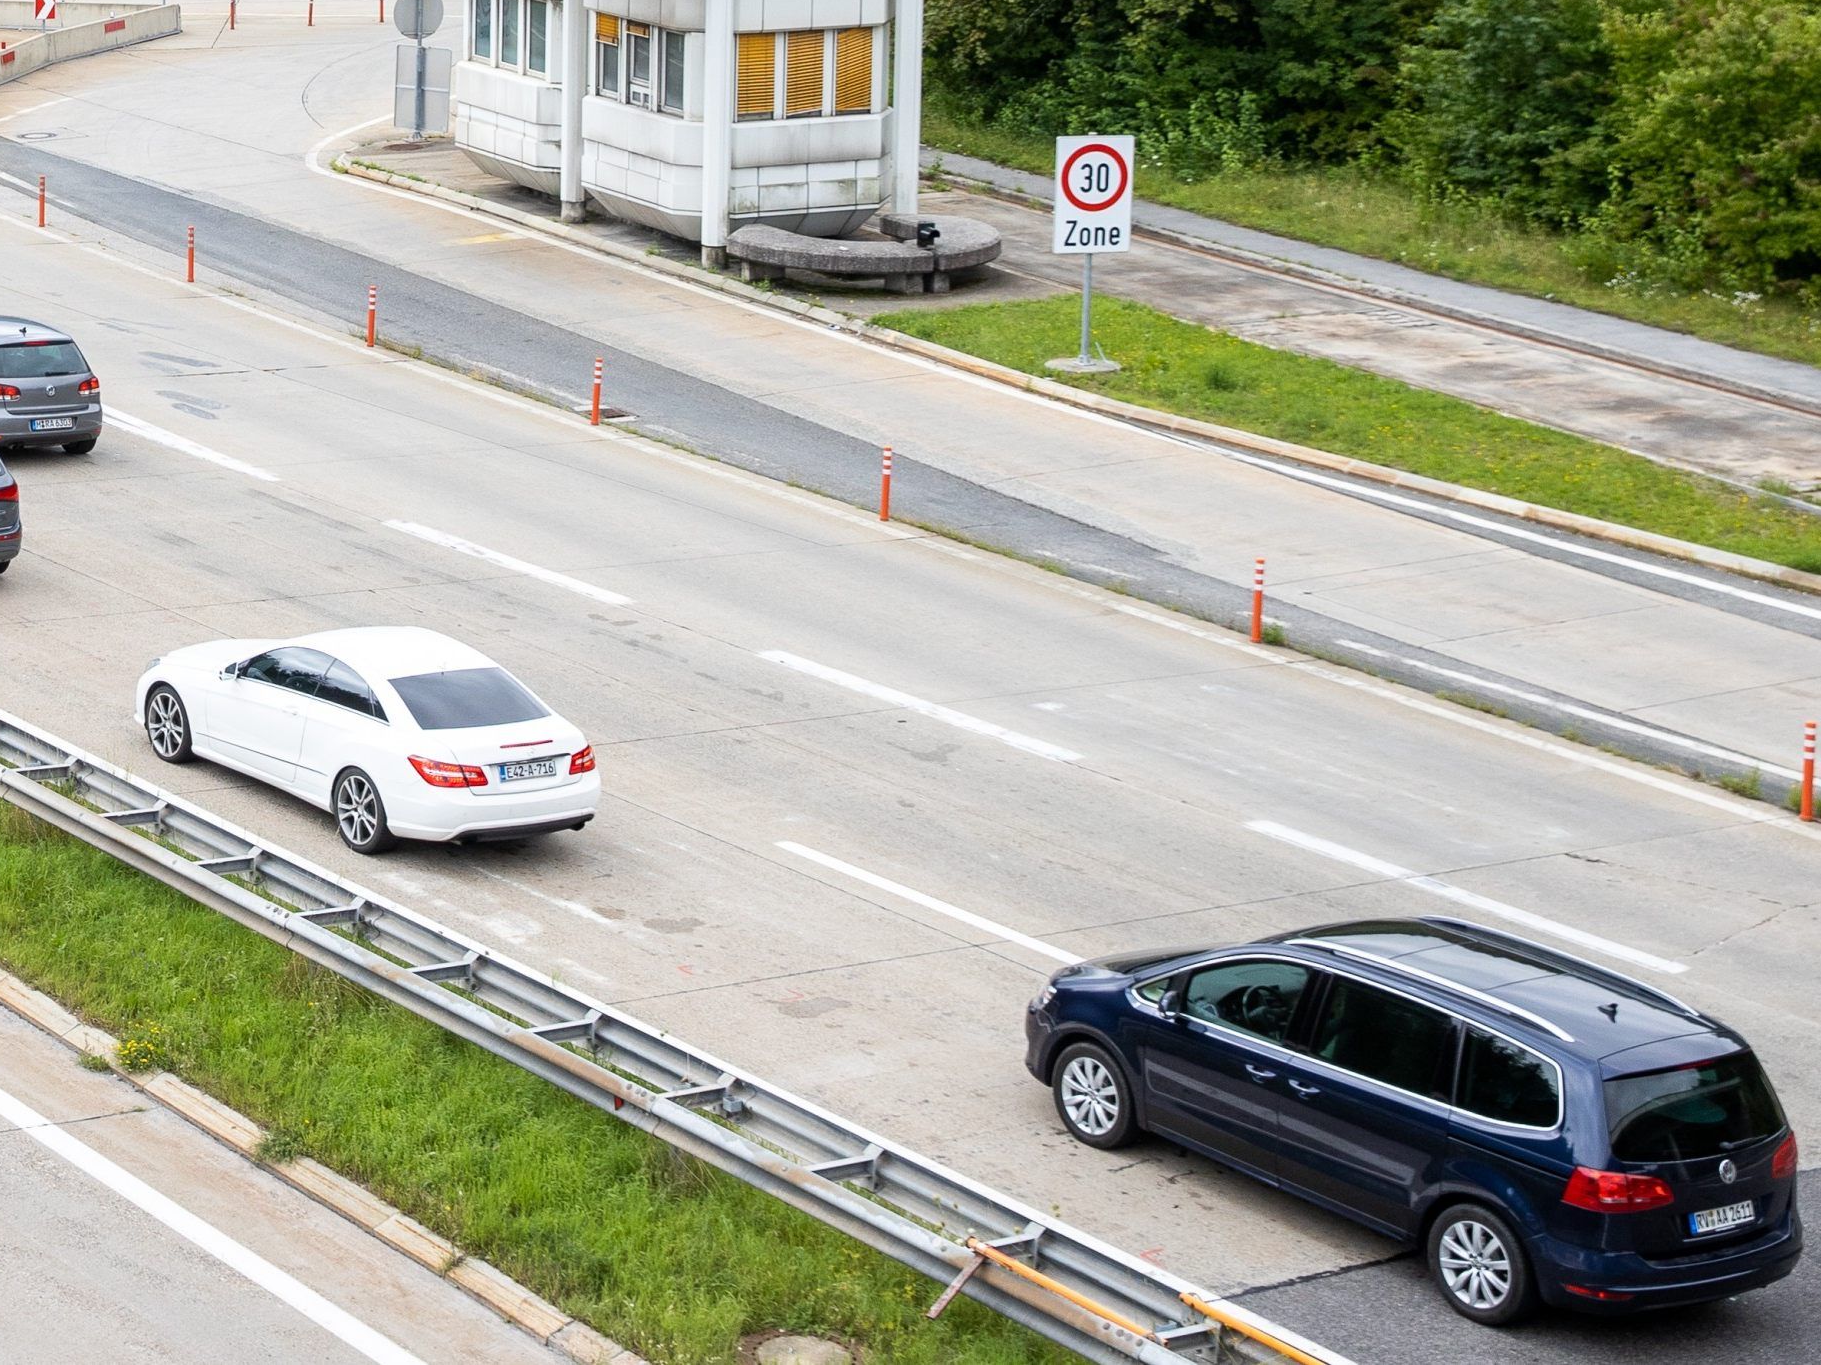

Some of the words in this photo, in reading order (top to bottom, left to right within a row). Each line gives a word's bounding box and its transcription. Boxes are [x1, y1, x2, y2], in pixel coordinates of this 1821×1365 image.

[1079, 162, 1110, 193] 30
[1063, 219, 1121, 247] Zone
[507, 762, 554, 779] E42-A-716
[1696, 1213, 1710, 1229] RV
[1716, 1208, 1729, 1225] AA
[1729, 1202, 1753, 1222] 2611
